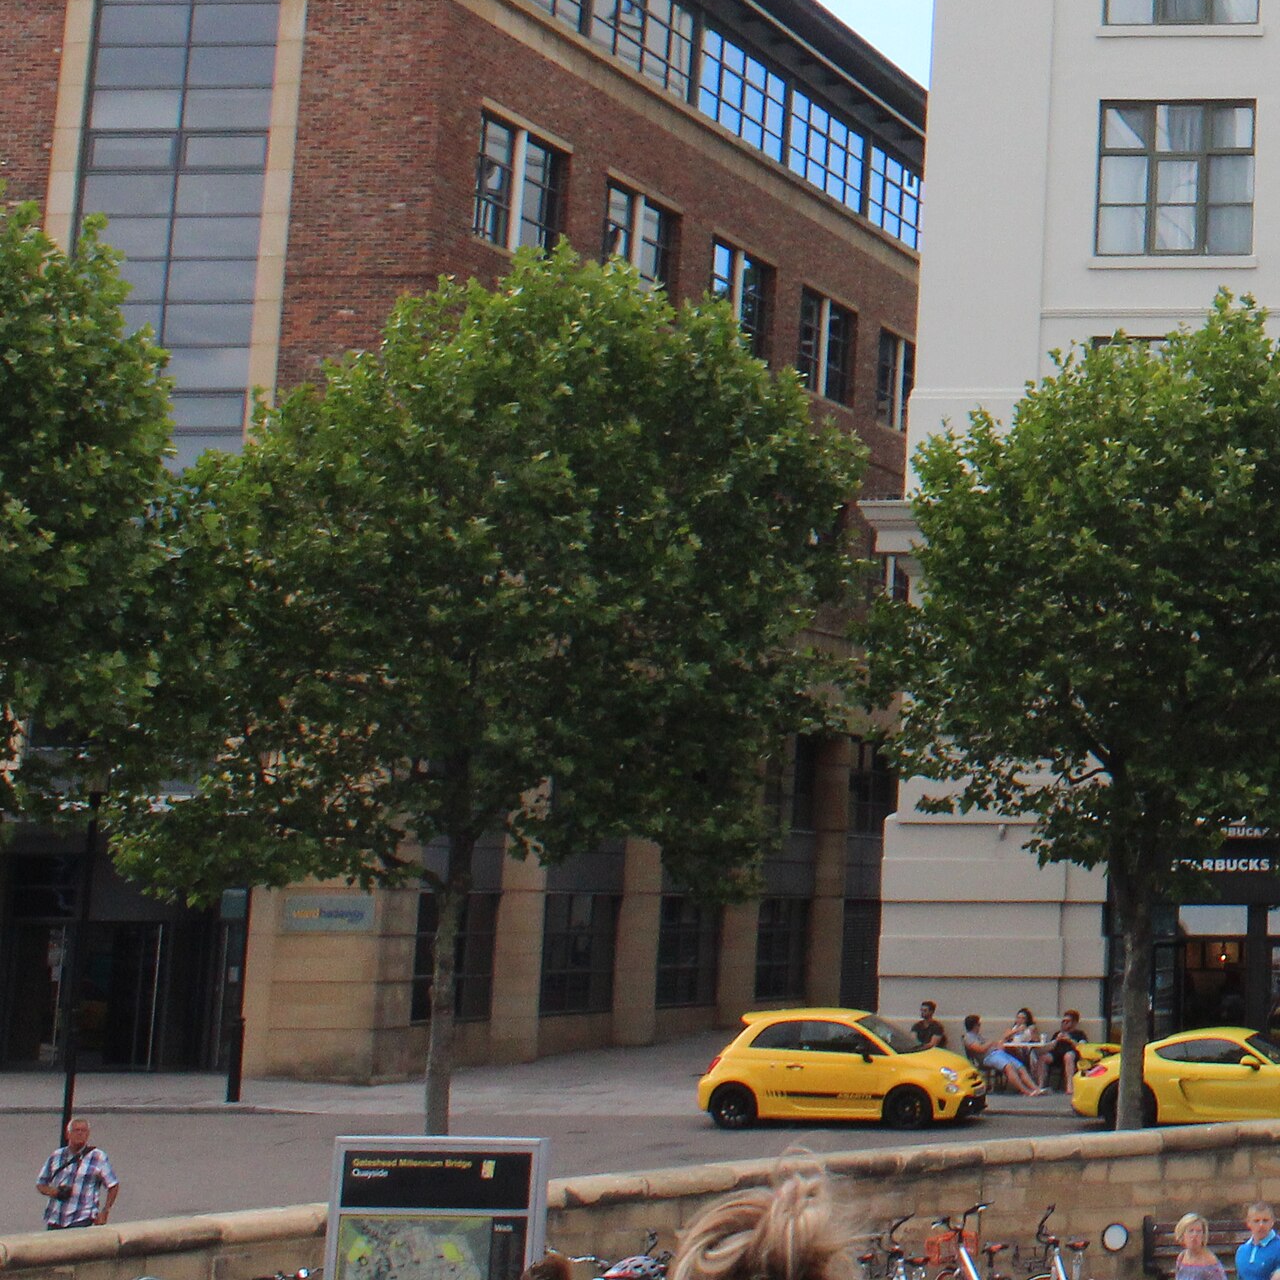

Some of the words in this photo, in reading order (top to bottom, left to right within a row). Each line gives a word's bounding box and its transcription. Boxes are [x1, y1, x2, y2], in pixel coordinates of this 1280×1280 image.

[399, 1159, 443, 1168] Millennium
[445, 1159, 473, 1169] Bridge
[352, 1168, 389, 1179] Quayside
